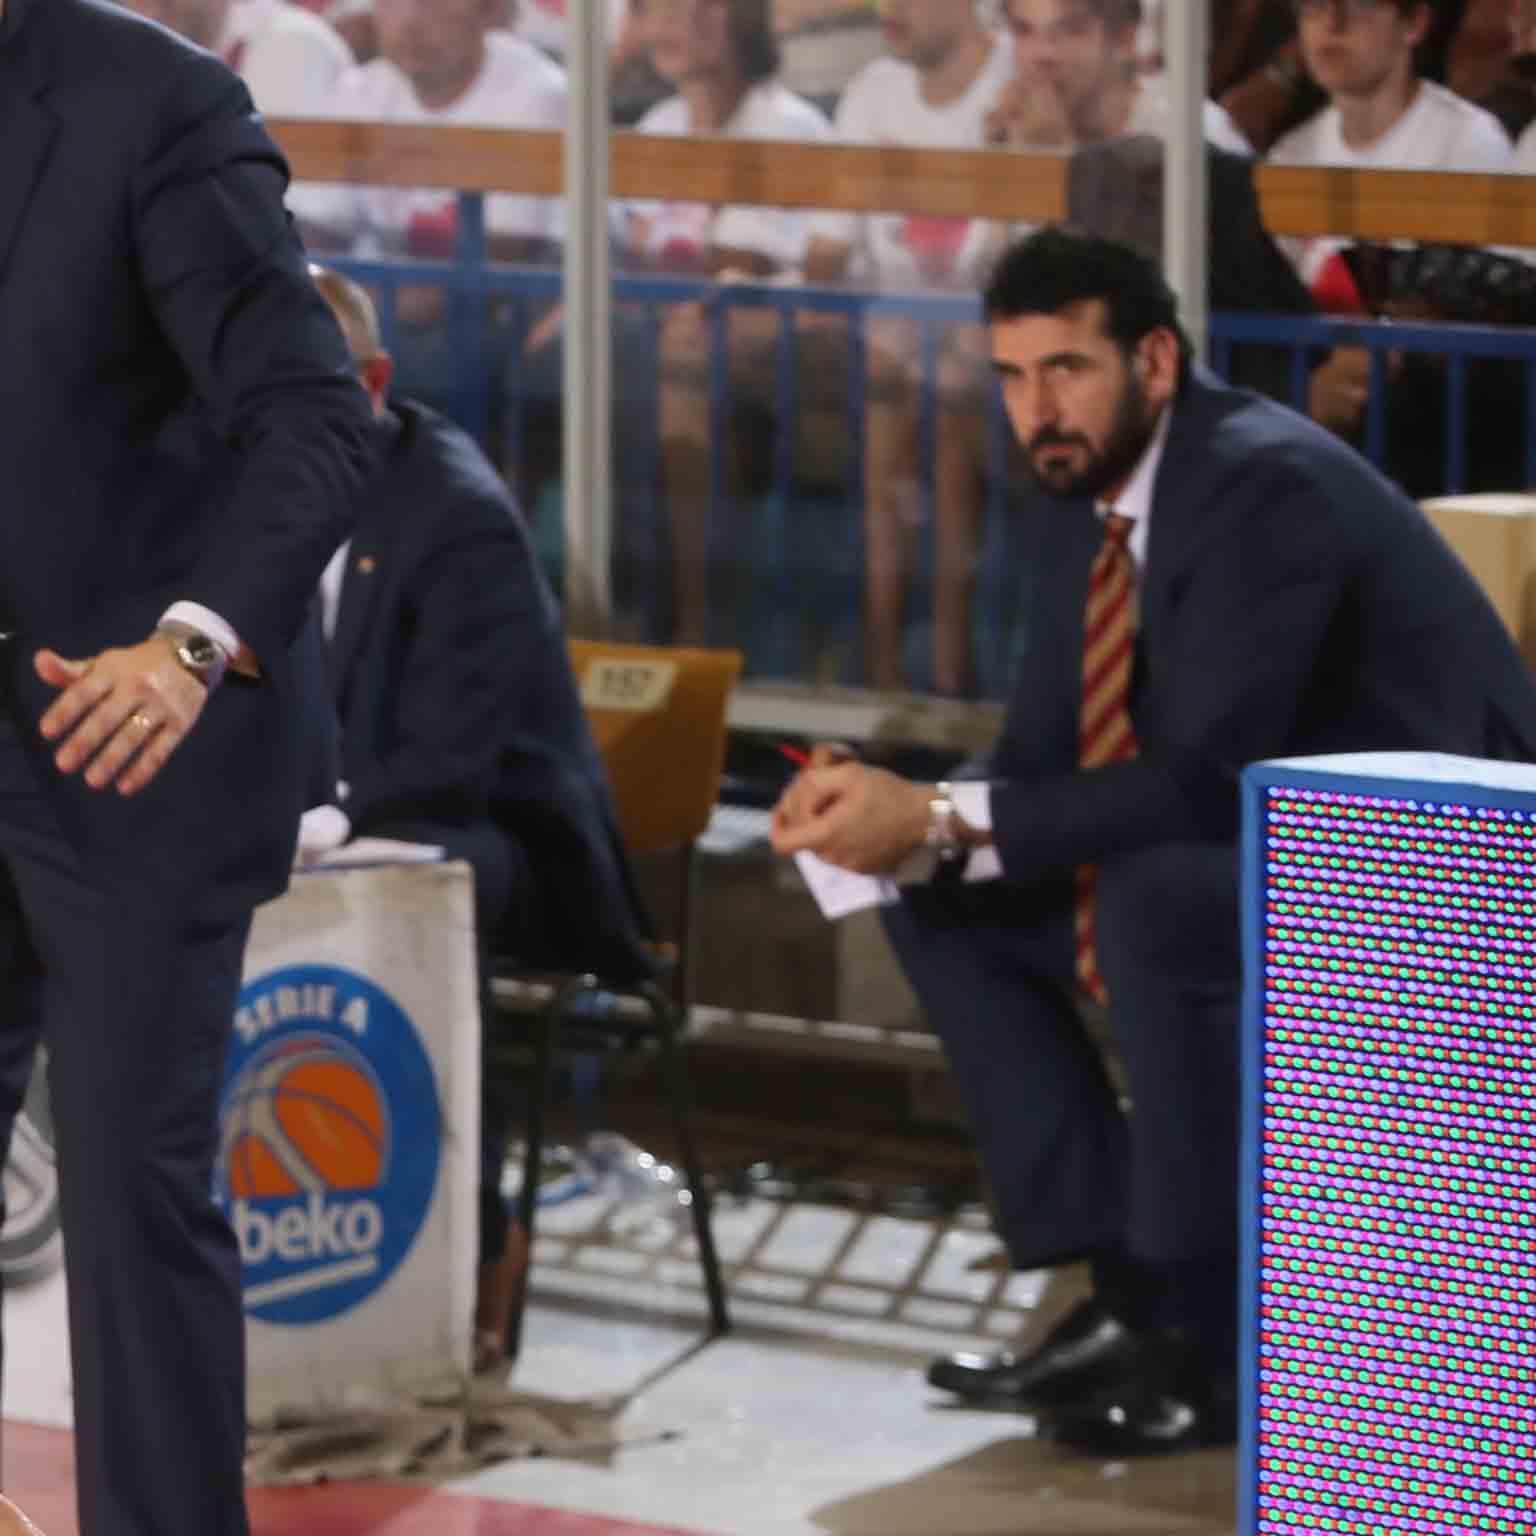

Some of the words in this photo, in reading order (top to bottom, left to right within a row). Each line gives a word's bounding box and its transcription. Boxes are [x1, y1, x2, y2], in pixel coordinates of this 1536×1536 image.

[234, 985, 336, 1044] SERIE
[340, 996, 369, 1036] A
[236, 1195, 382, 1264] beko
